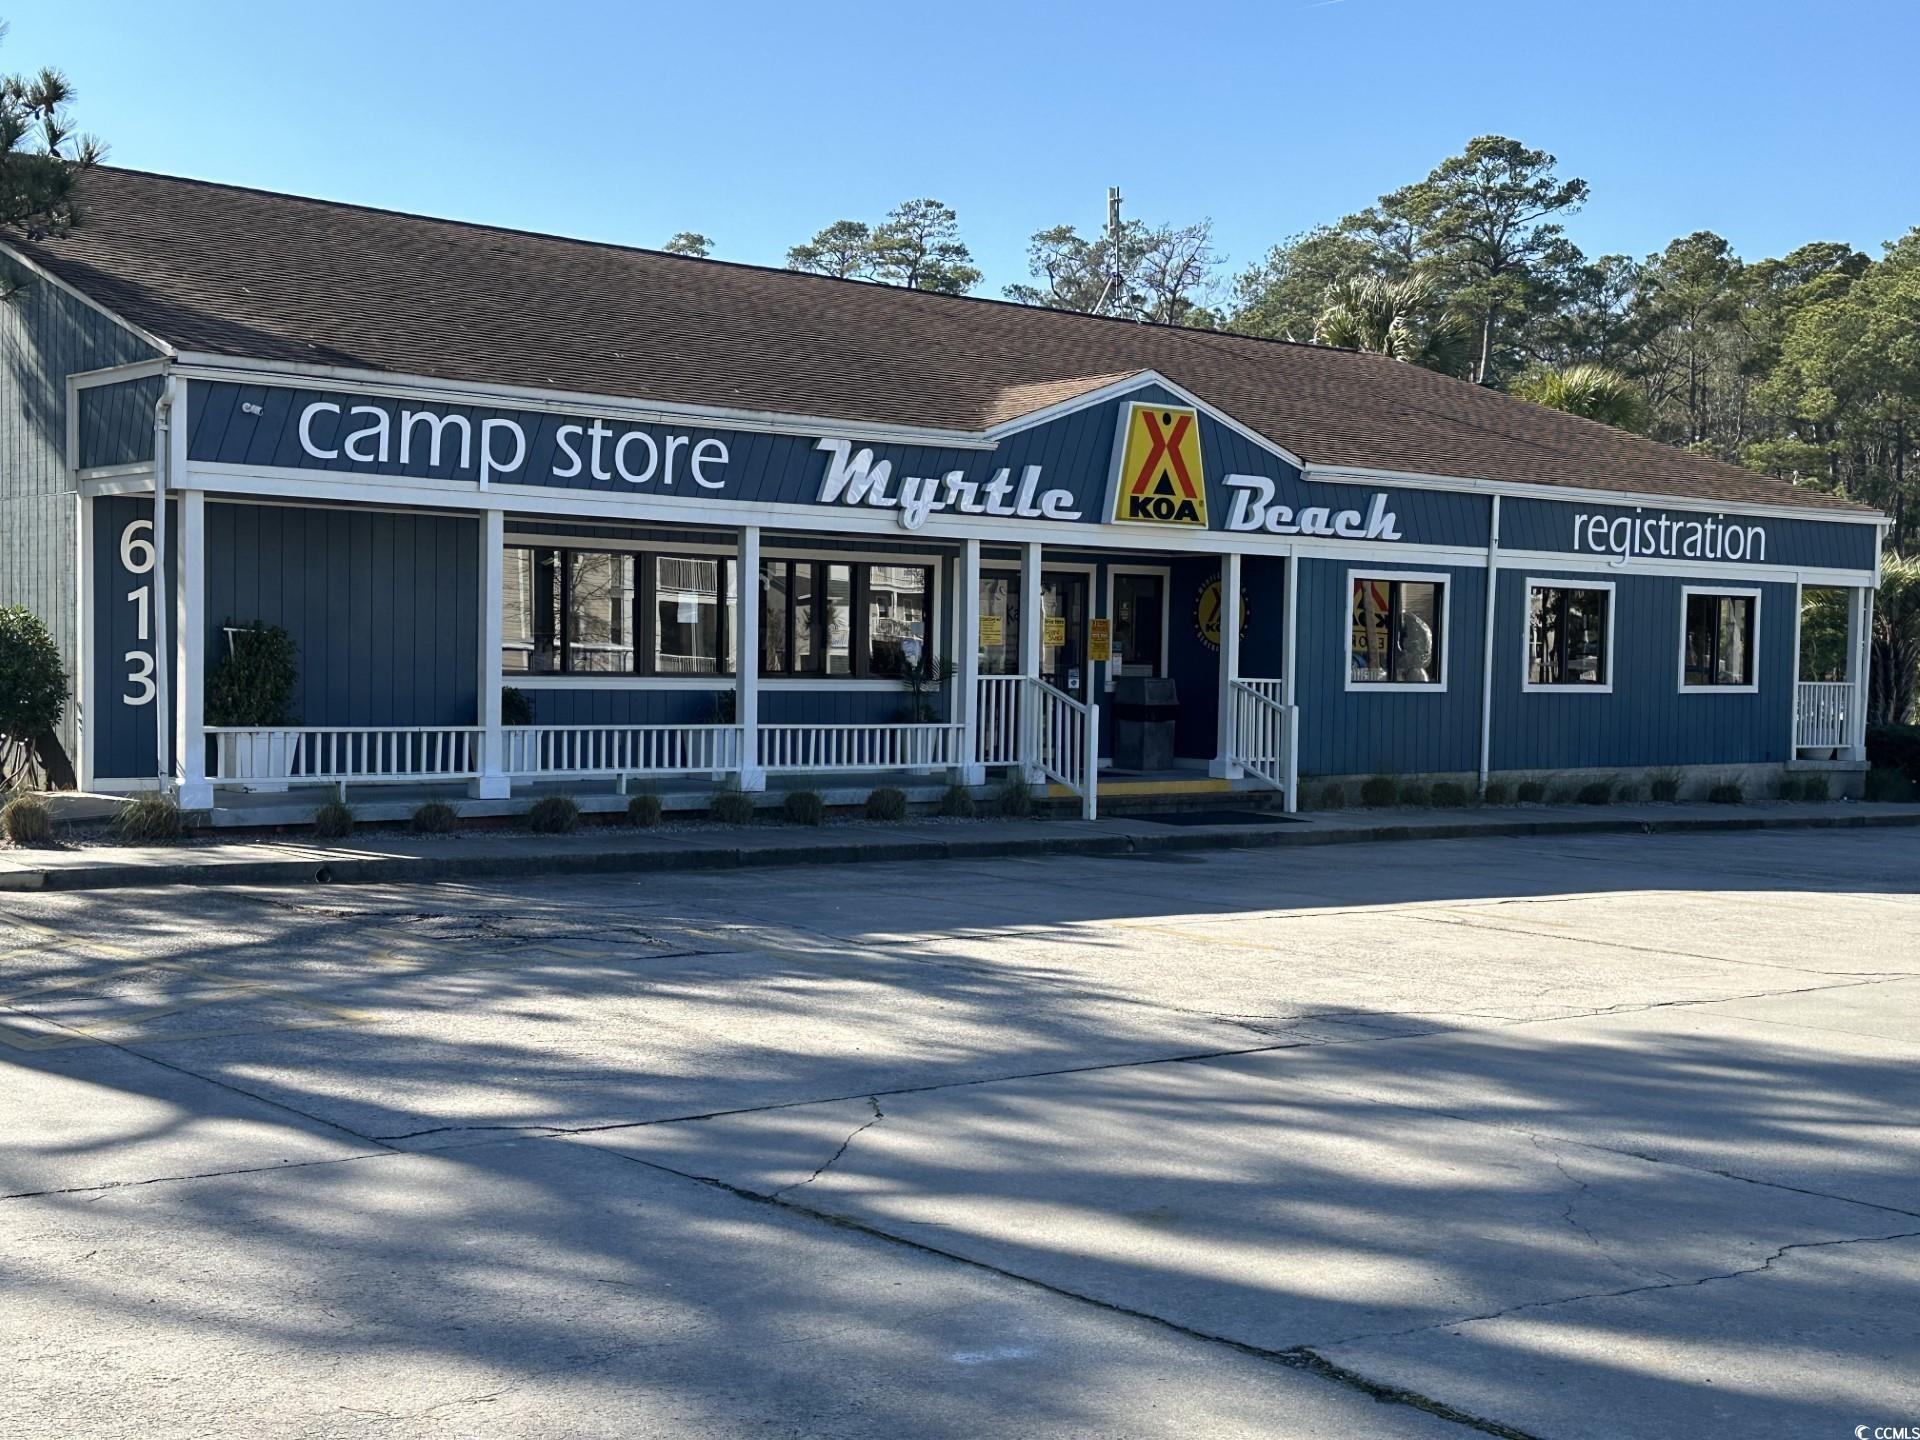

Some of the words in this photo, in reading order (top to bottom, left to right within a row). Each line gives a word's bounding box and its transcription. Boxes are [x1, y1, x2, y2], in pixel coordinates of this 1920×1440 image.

[298, 402, 526, 492] camp
[552, 418, 729, 489] store
[816, 437, 1083, 530] Myrtle
[1222, 473, 1402, 541] Beach
[1129, 495, 1200, 521] KOA
[1573, 507, 1766, 567] registration
[120, 519, 156, 706] 613
